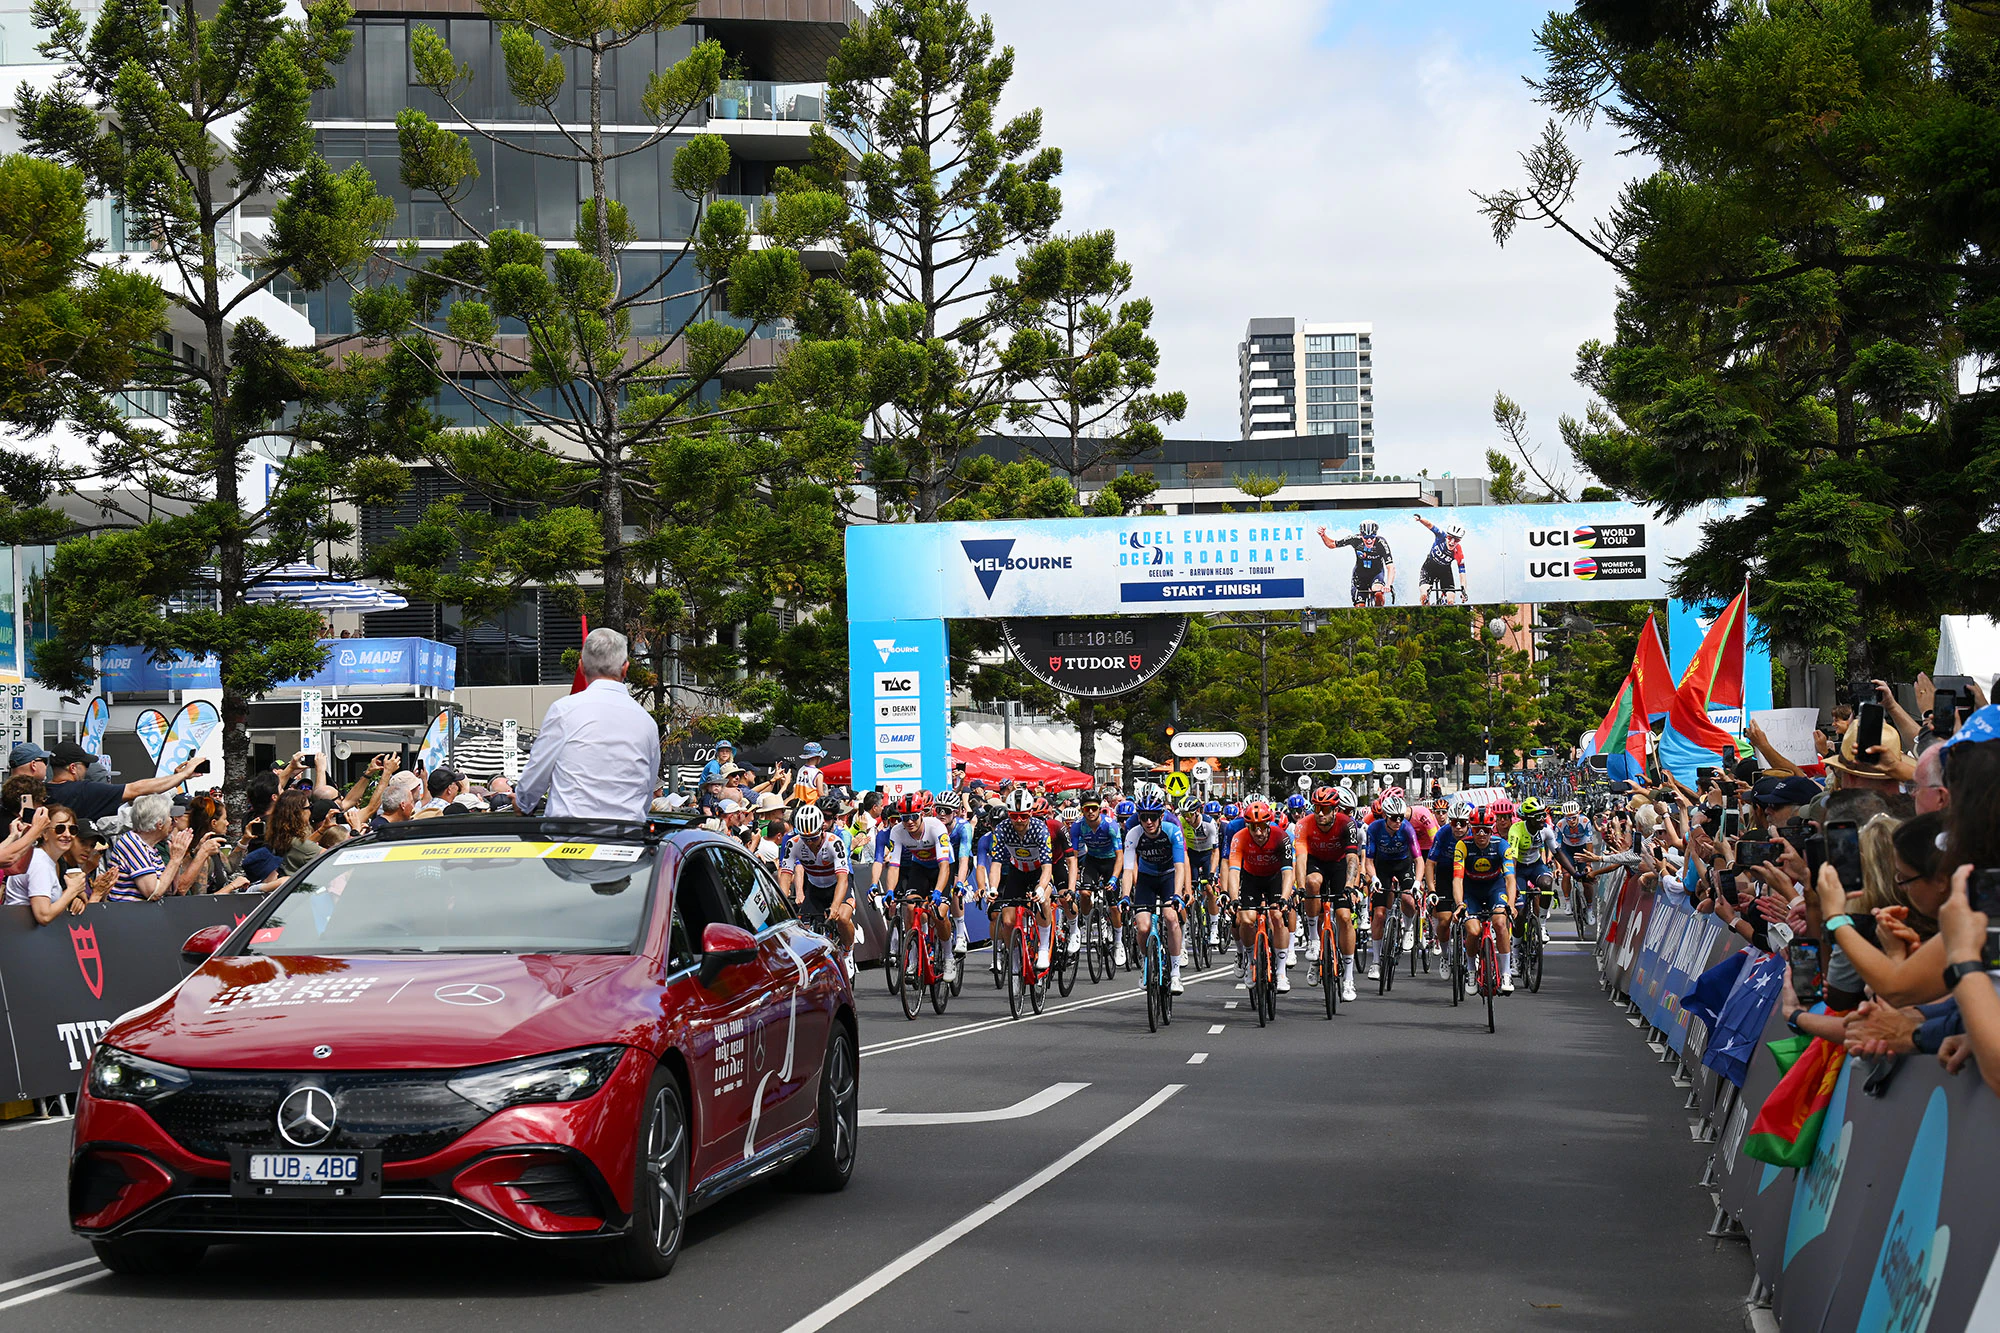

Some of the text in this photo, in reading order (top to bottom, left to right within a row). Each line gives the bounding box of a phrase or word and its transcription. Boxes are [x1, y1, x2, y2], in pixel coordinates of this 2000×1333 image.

[1119, 527, 1304, 549] CADEL EVANS GREAT
[1600, 528, 1636, 537] WORLD
[1529, 530, 1569, 547] UCI
[1602, 536, 1629, 545] TOUR
[1119, 546, 1304, 566] OCEAN ROAD RACE
[971, 556, 1073, 571] MELBOURNE
[1148, 569, 1174, 577] GEELONG
[1189, 568, 1214, 576] BARWON
[1214, 567, 1234, 576] HEADS
[1249, 566, 1275, 575] TORQUAY
[1529, 562, 1569, 578] UCI
[1601, 567, 1642, 575] WORLDTOUR
[1162, 585, 1206, 597] START
[1215, 583, 1262, 596] FINISH
[1057, 630, 1134, 646] 11:10:06
[877, 646, 919, 654] MELBOURNE
[359, 650, 403, 665] MAPEI
[1064, 656, 1126, 670] TUDOR
[881, 677, 912, 691] TAC
[10, 685, 26, 697] 3P
[892, 705, 917, 713] DEAKIN
[505, 720, 517, 729] 3P
[1714, 715, 1740, 724] MAPEI
[13, 729, 21, 741] P
[890, 734, 915, 743] MAPEI
[504, 752, 516, 760] 3P
[1195, 766, 1208, 774] 25m
[1343, 762, 1367, 770] MAPEI
[421, 846, 512, 856] RACE DIRECTOR
[263, 1157, 301, 1179] 1UB
